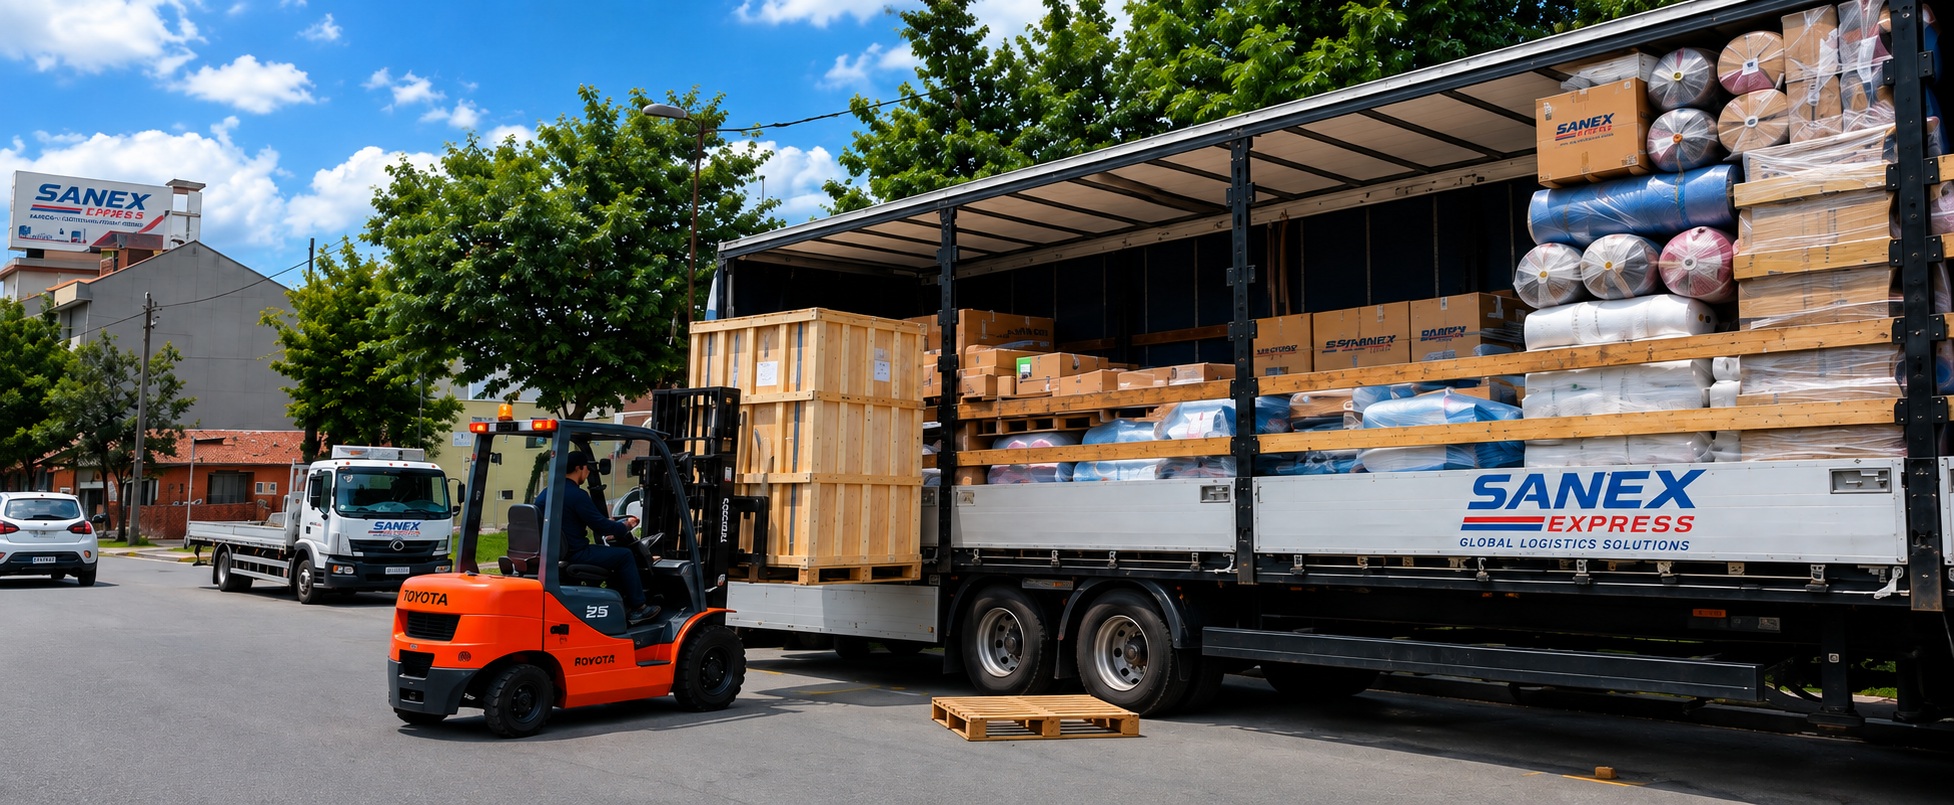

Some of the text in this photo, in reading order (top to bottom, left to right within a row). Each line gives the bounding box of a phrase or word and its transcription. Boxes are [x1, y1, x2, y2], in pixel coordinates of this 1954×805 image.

[1556, 112, 1615, 135] SANEX
[35, 183, 152, 211] SANEX
[1467, 469, 1707, 510] SANEX
[1547, 515, 1695, 533] EXPRESS
[1459, 537, 1690, 551] GLOBAL LOGISTICS SOLUTIONS
[403, 589, 448, 606] TOYOTA
[585, 605, 609, 619] 25
